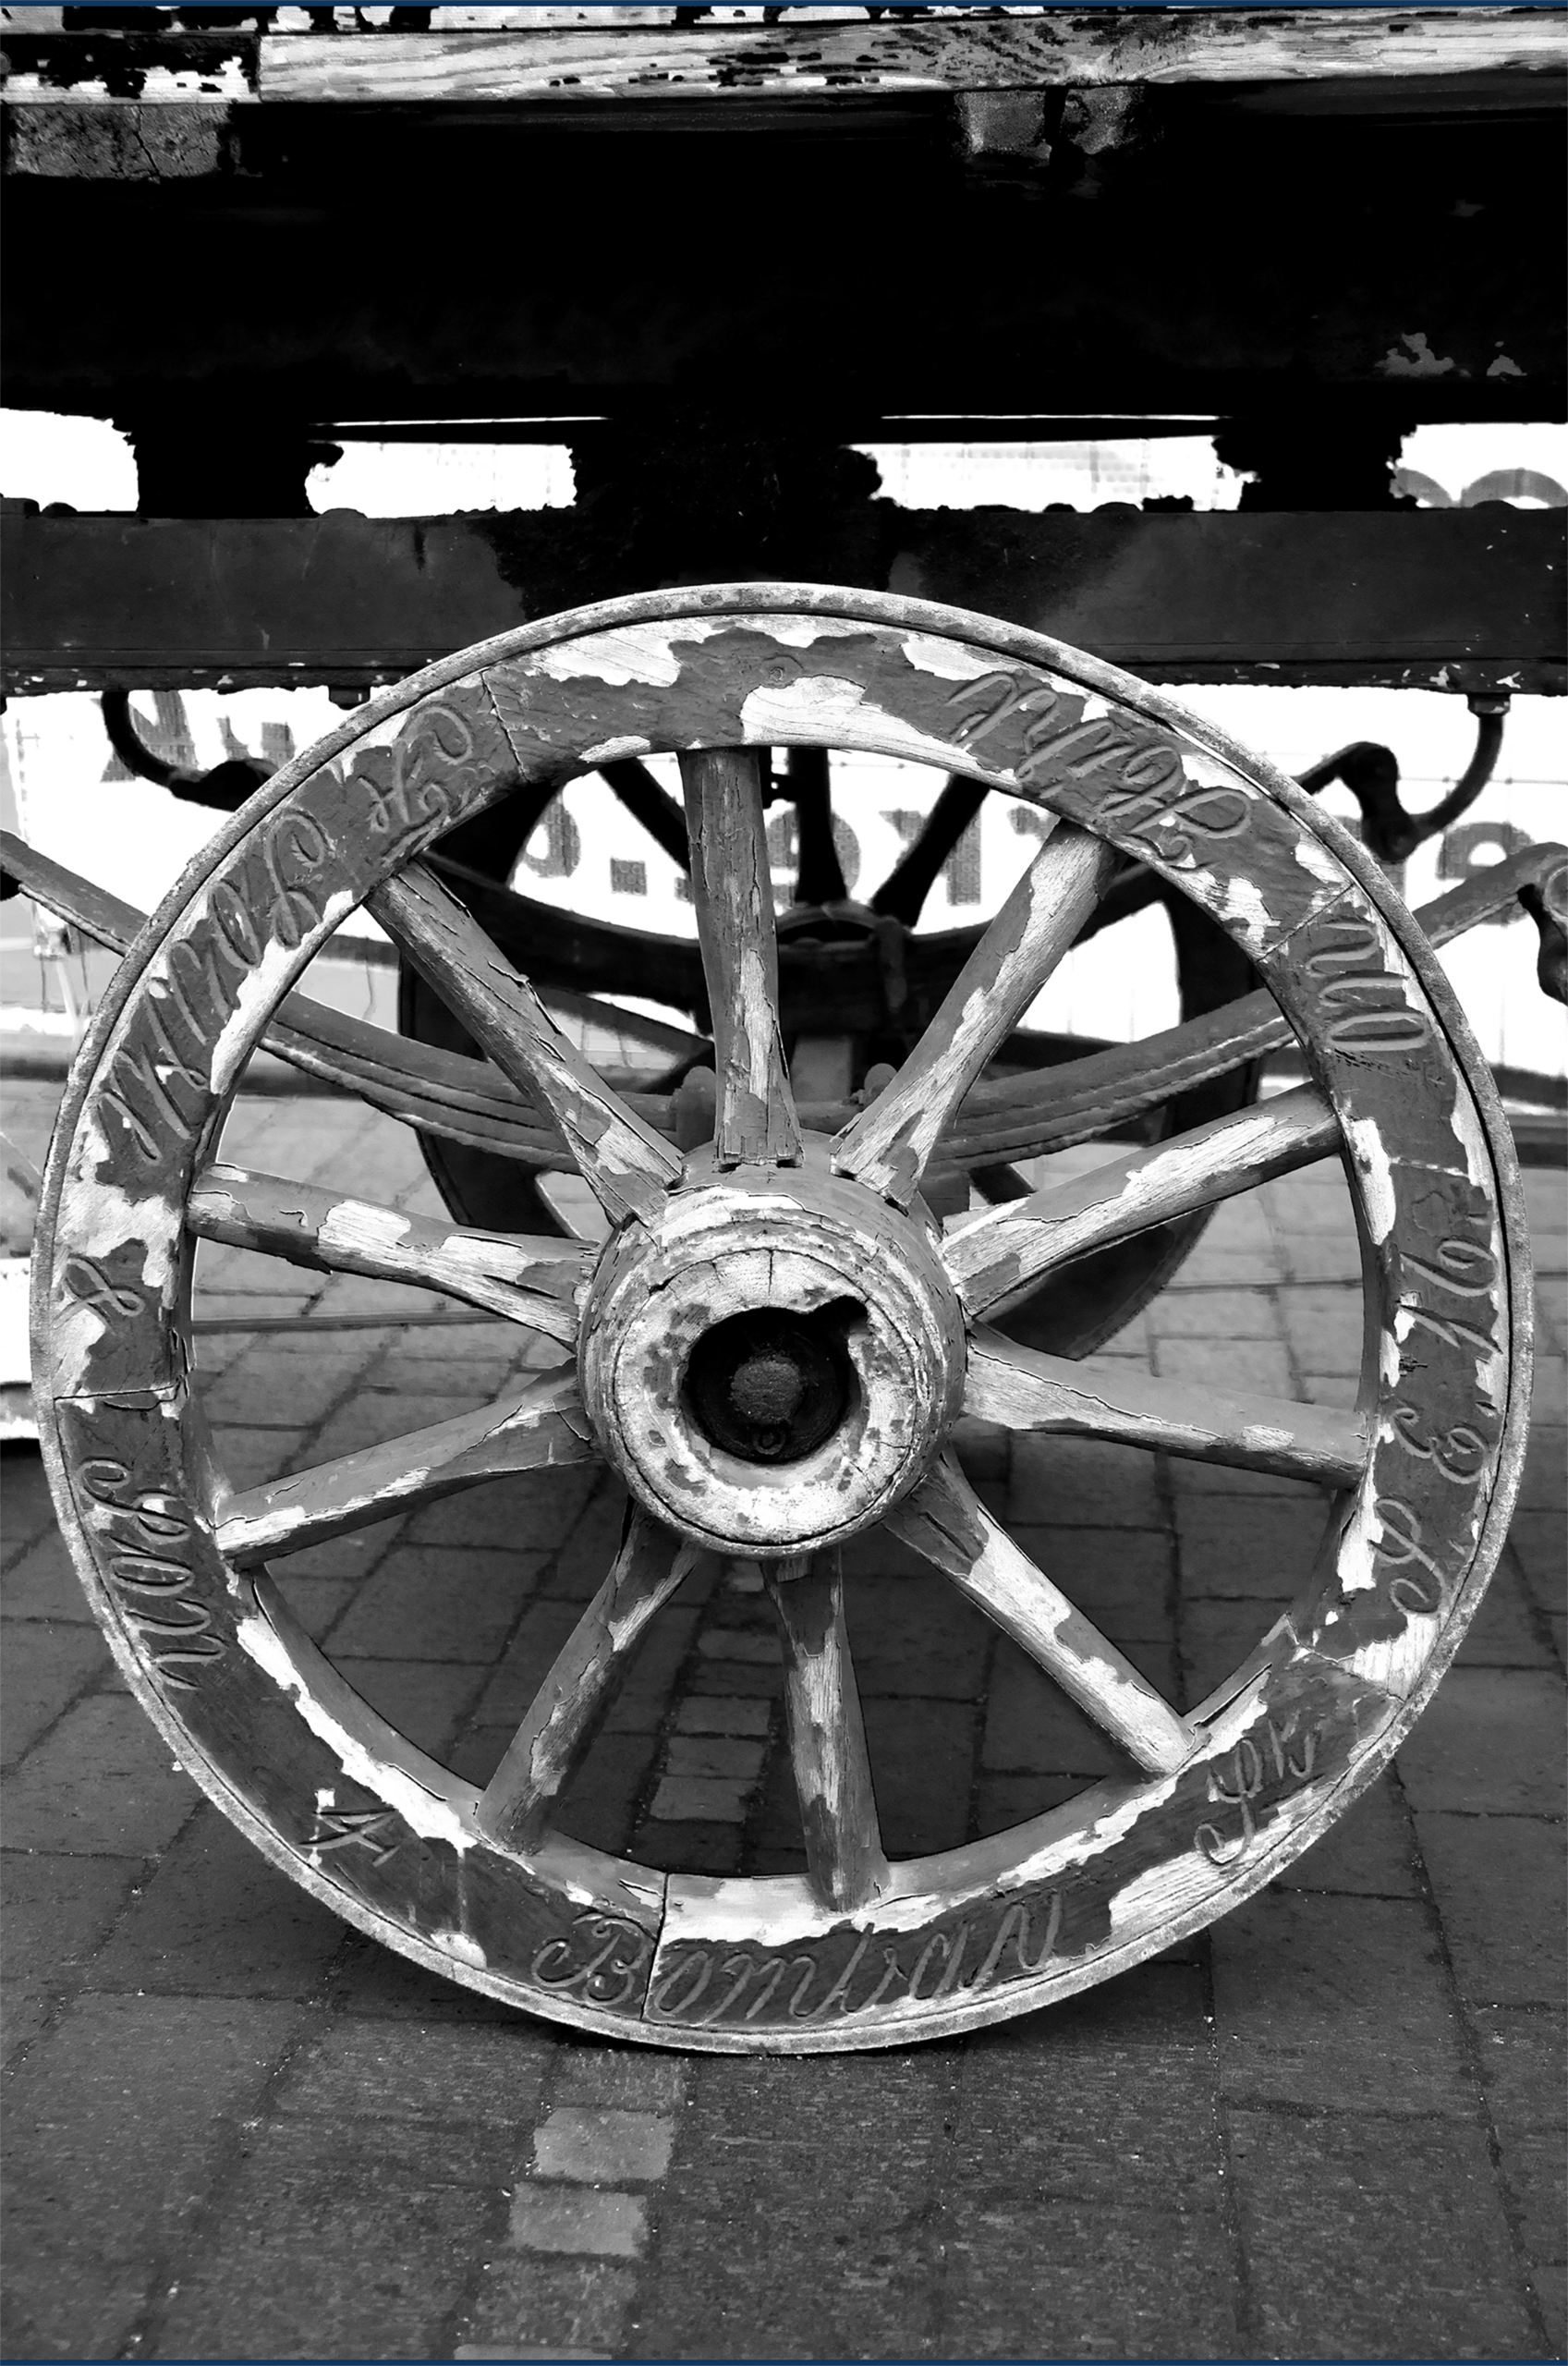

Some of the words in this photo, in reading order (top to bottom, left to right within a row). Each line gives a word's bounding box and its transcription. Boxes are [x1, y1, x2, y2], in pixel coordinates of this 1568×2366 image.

[945, 670, 1252, 872] Hire
[1304, 915, 1430, 1052] On
[52, 1251, 146, 1335] &
[78, 1457, 229, 1690] Son
